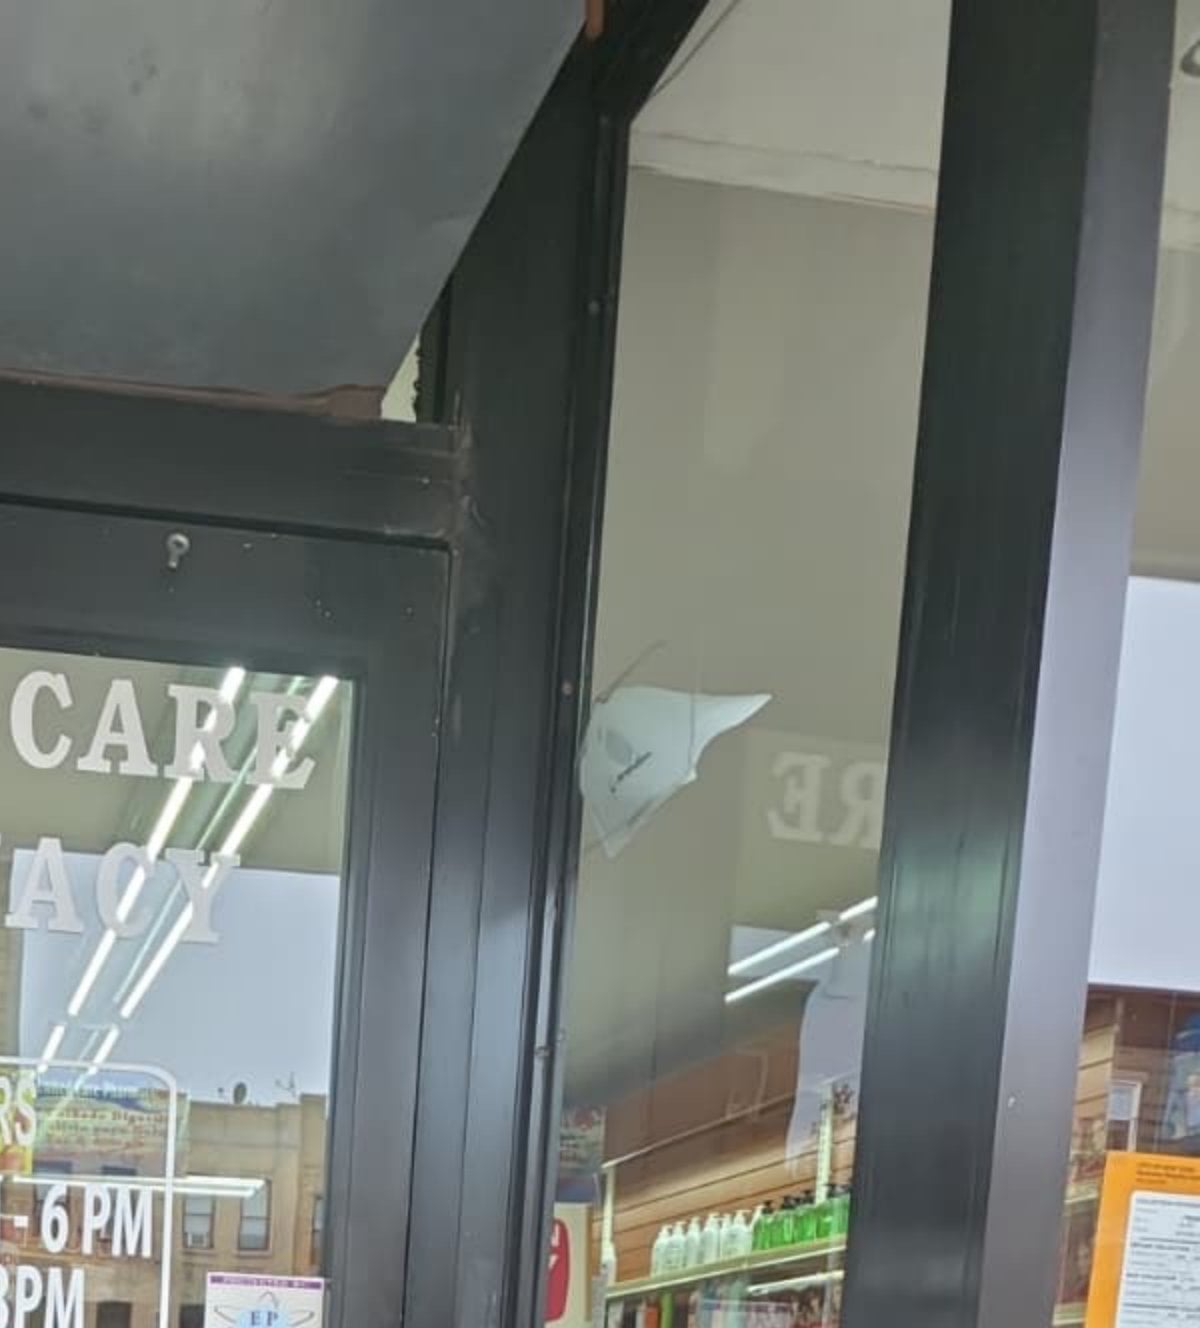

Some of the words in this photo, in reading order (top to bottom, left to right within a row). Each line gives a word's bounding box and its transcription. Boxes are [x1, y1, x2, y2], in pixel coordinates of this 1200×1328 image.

[9, 670, 318, 791] CARE
[40, 1184, 69, 1255] 6
[82, 1184, 154, 1259] PM
